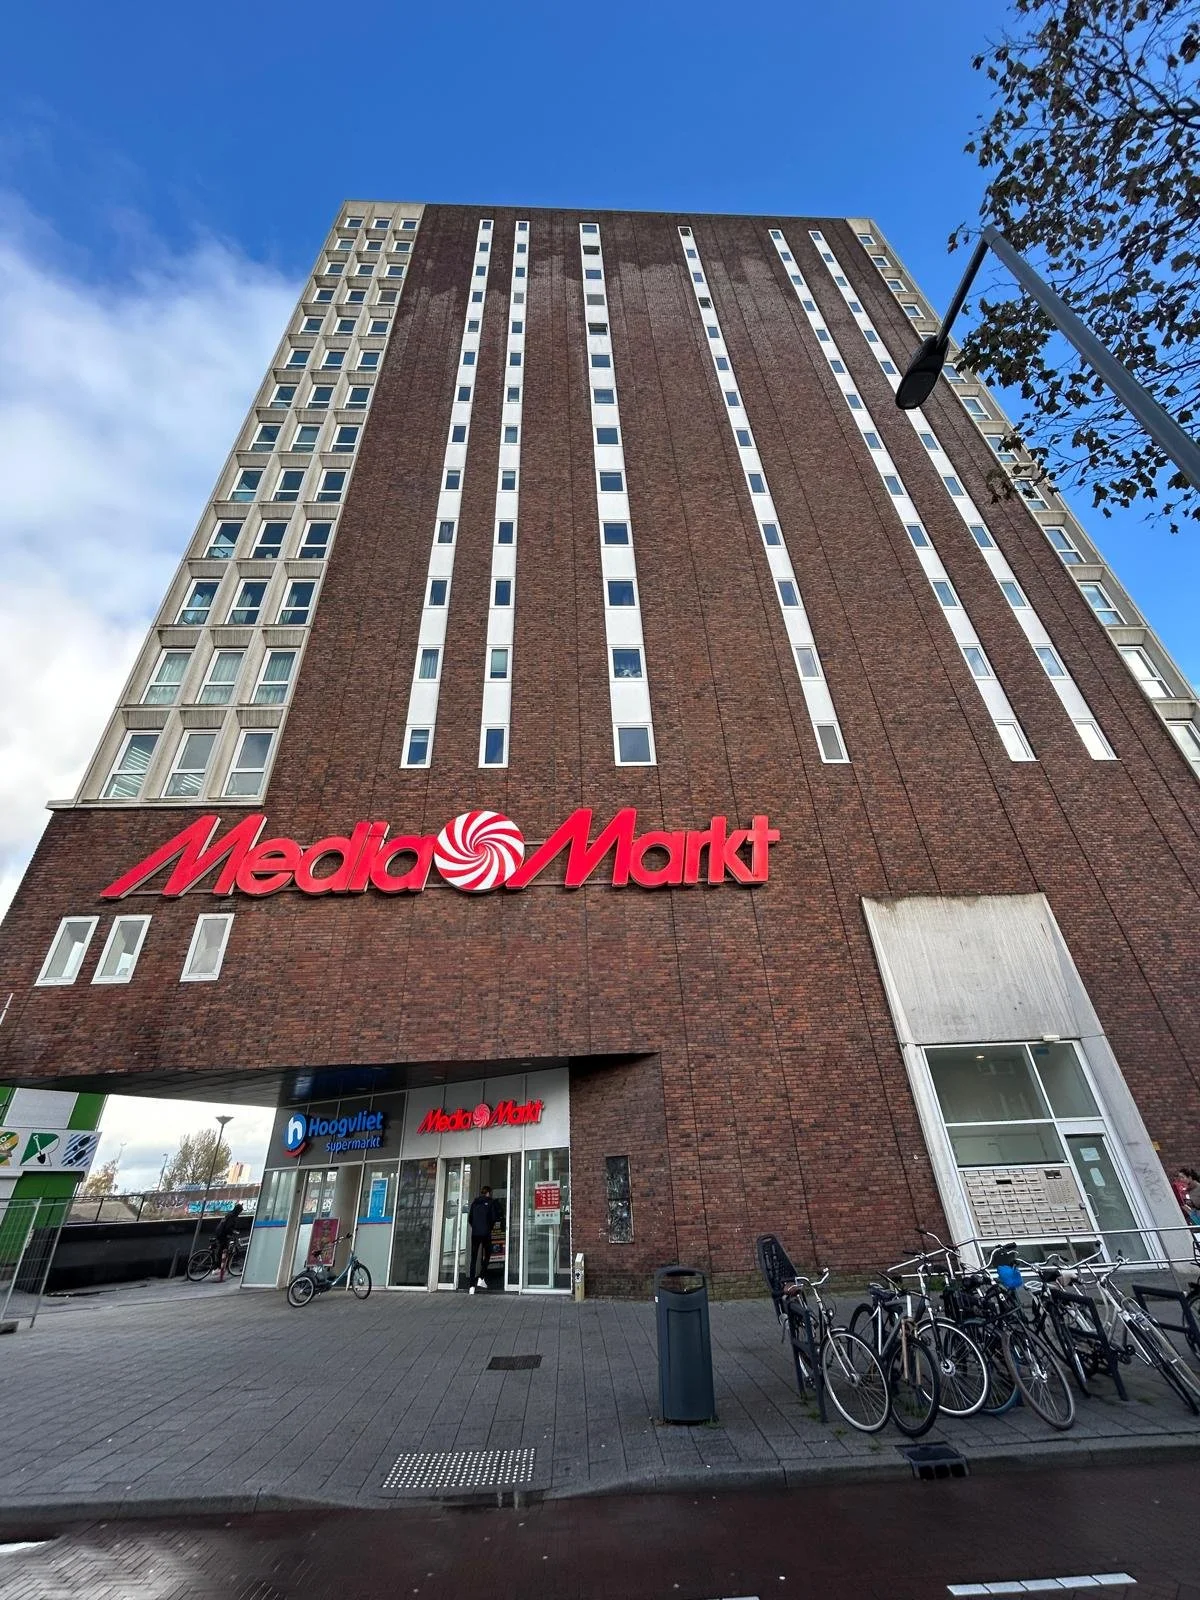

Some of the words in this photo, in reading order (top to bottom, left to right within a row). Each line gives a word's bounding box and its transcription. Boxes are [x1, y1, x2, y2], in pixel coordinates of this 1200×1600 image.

[101, 815, 432, 898] Media
[508, 808, 780, 889] Markt
[309, 1111, 383, 1137] Hoogvliet
[417, 1107, 473, 1134] Media
[489, 1099, 544, 1125] Markt
[326, 1137, 380, 1153] supermarkt
